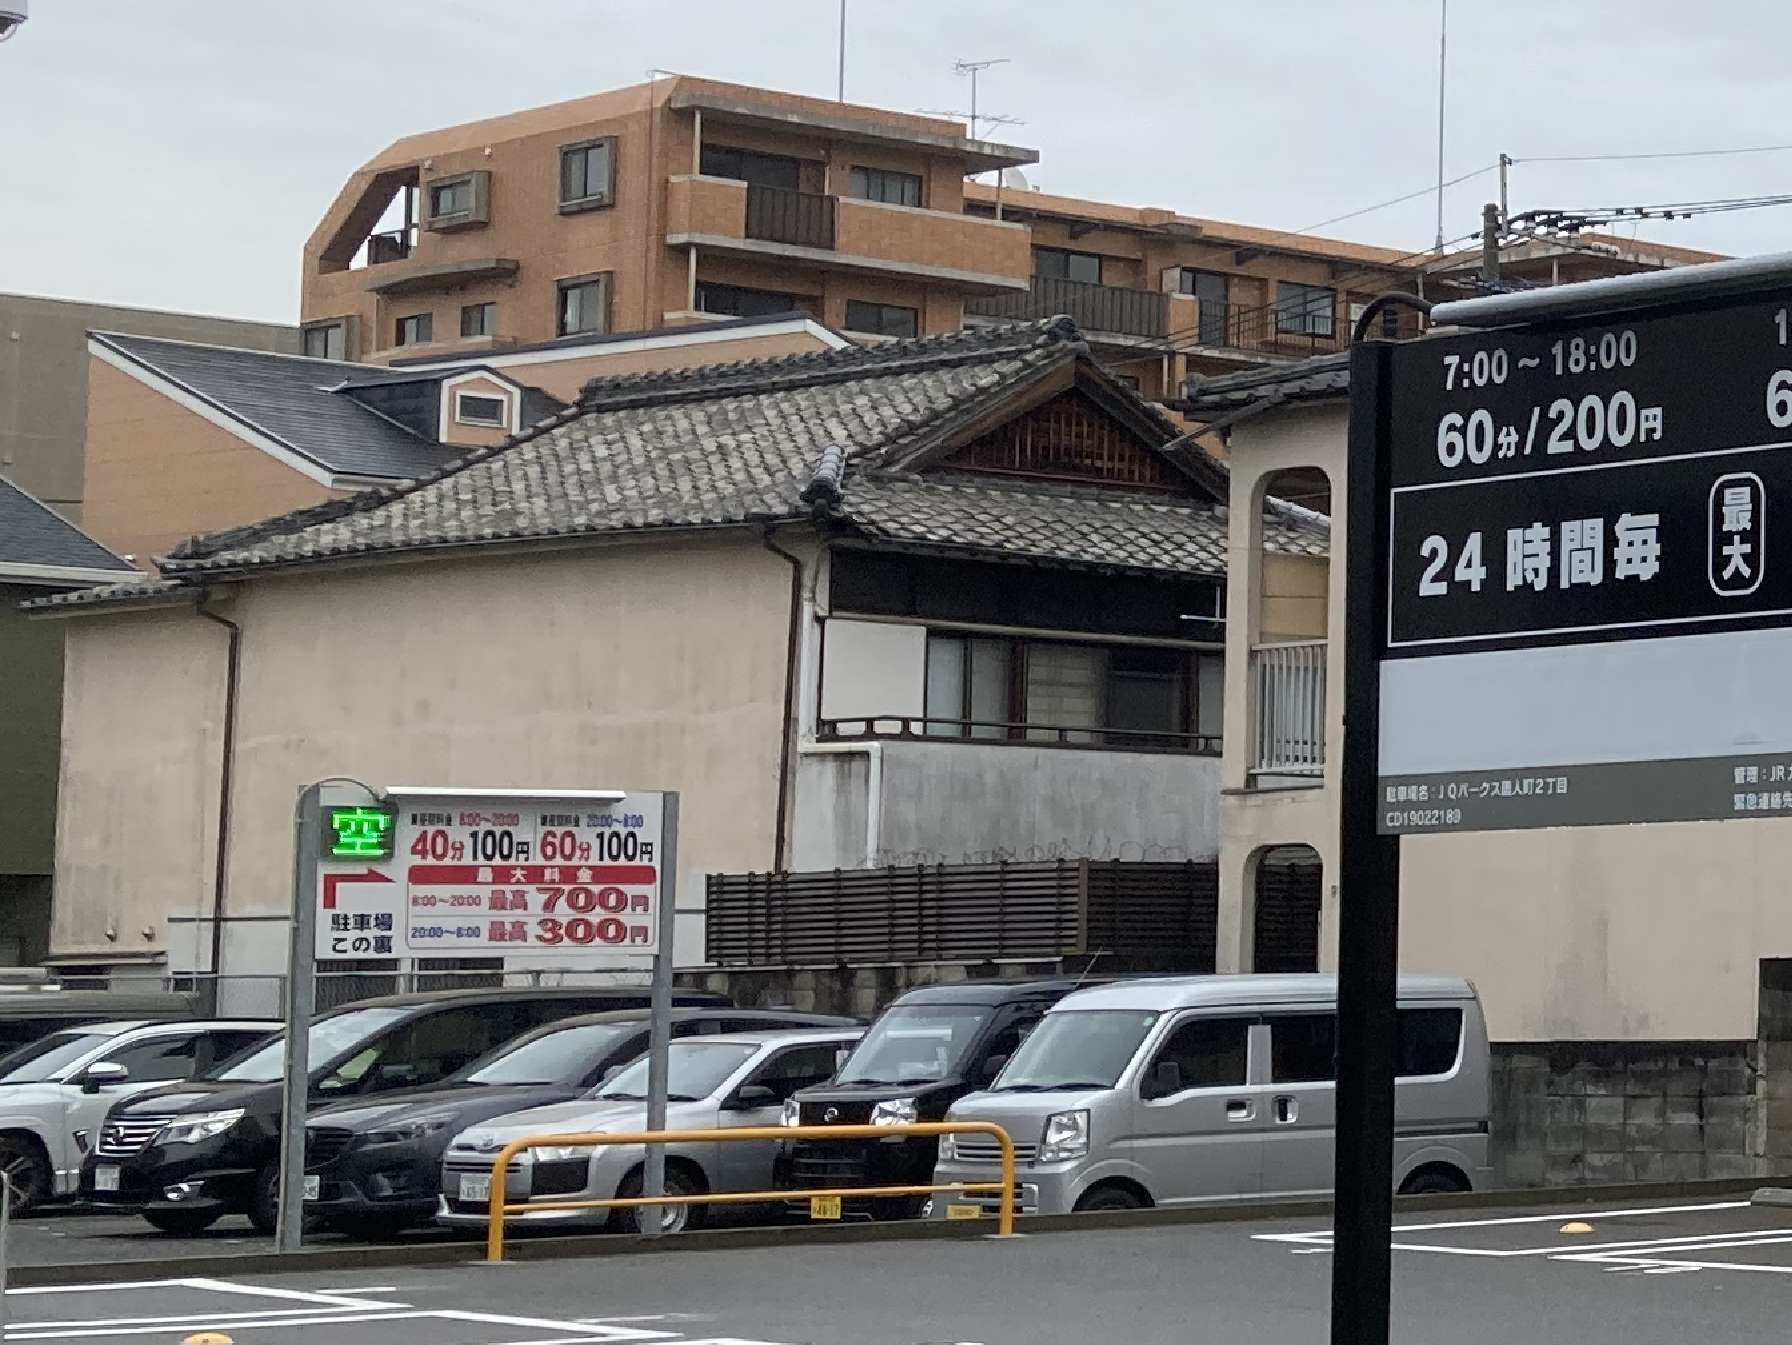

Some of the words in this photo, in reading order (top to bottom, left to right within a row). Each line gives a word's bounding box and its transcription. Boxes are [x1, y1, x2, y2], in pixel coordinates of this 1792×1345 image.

[1722, 486, 1753, 581] 最大
[332, 807, 389, 856] 空
[469, 829, 530, 862] 100円
[596, 830, 654, 863] 100円
[535, 886, 650, 914] 700円
[331, 913, 393, 932] 駐車場
[535, 917, 649, 945] 300円
